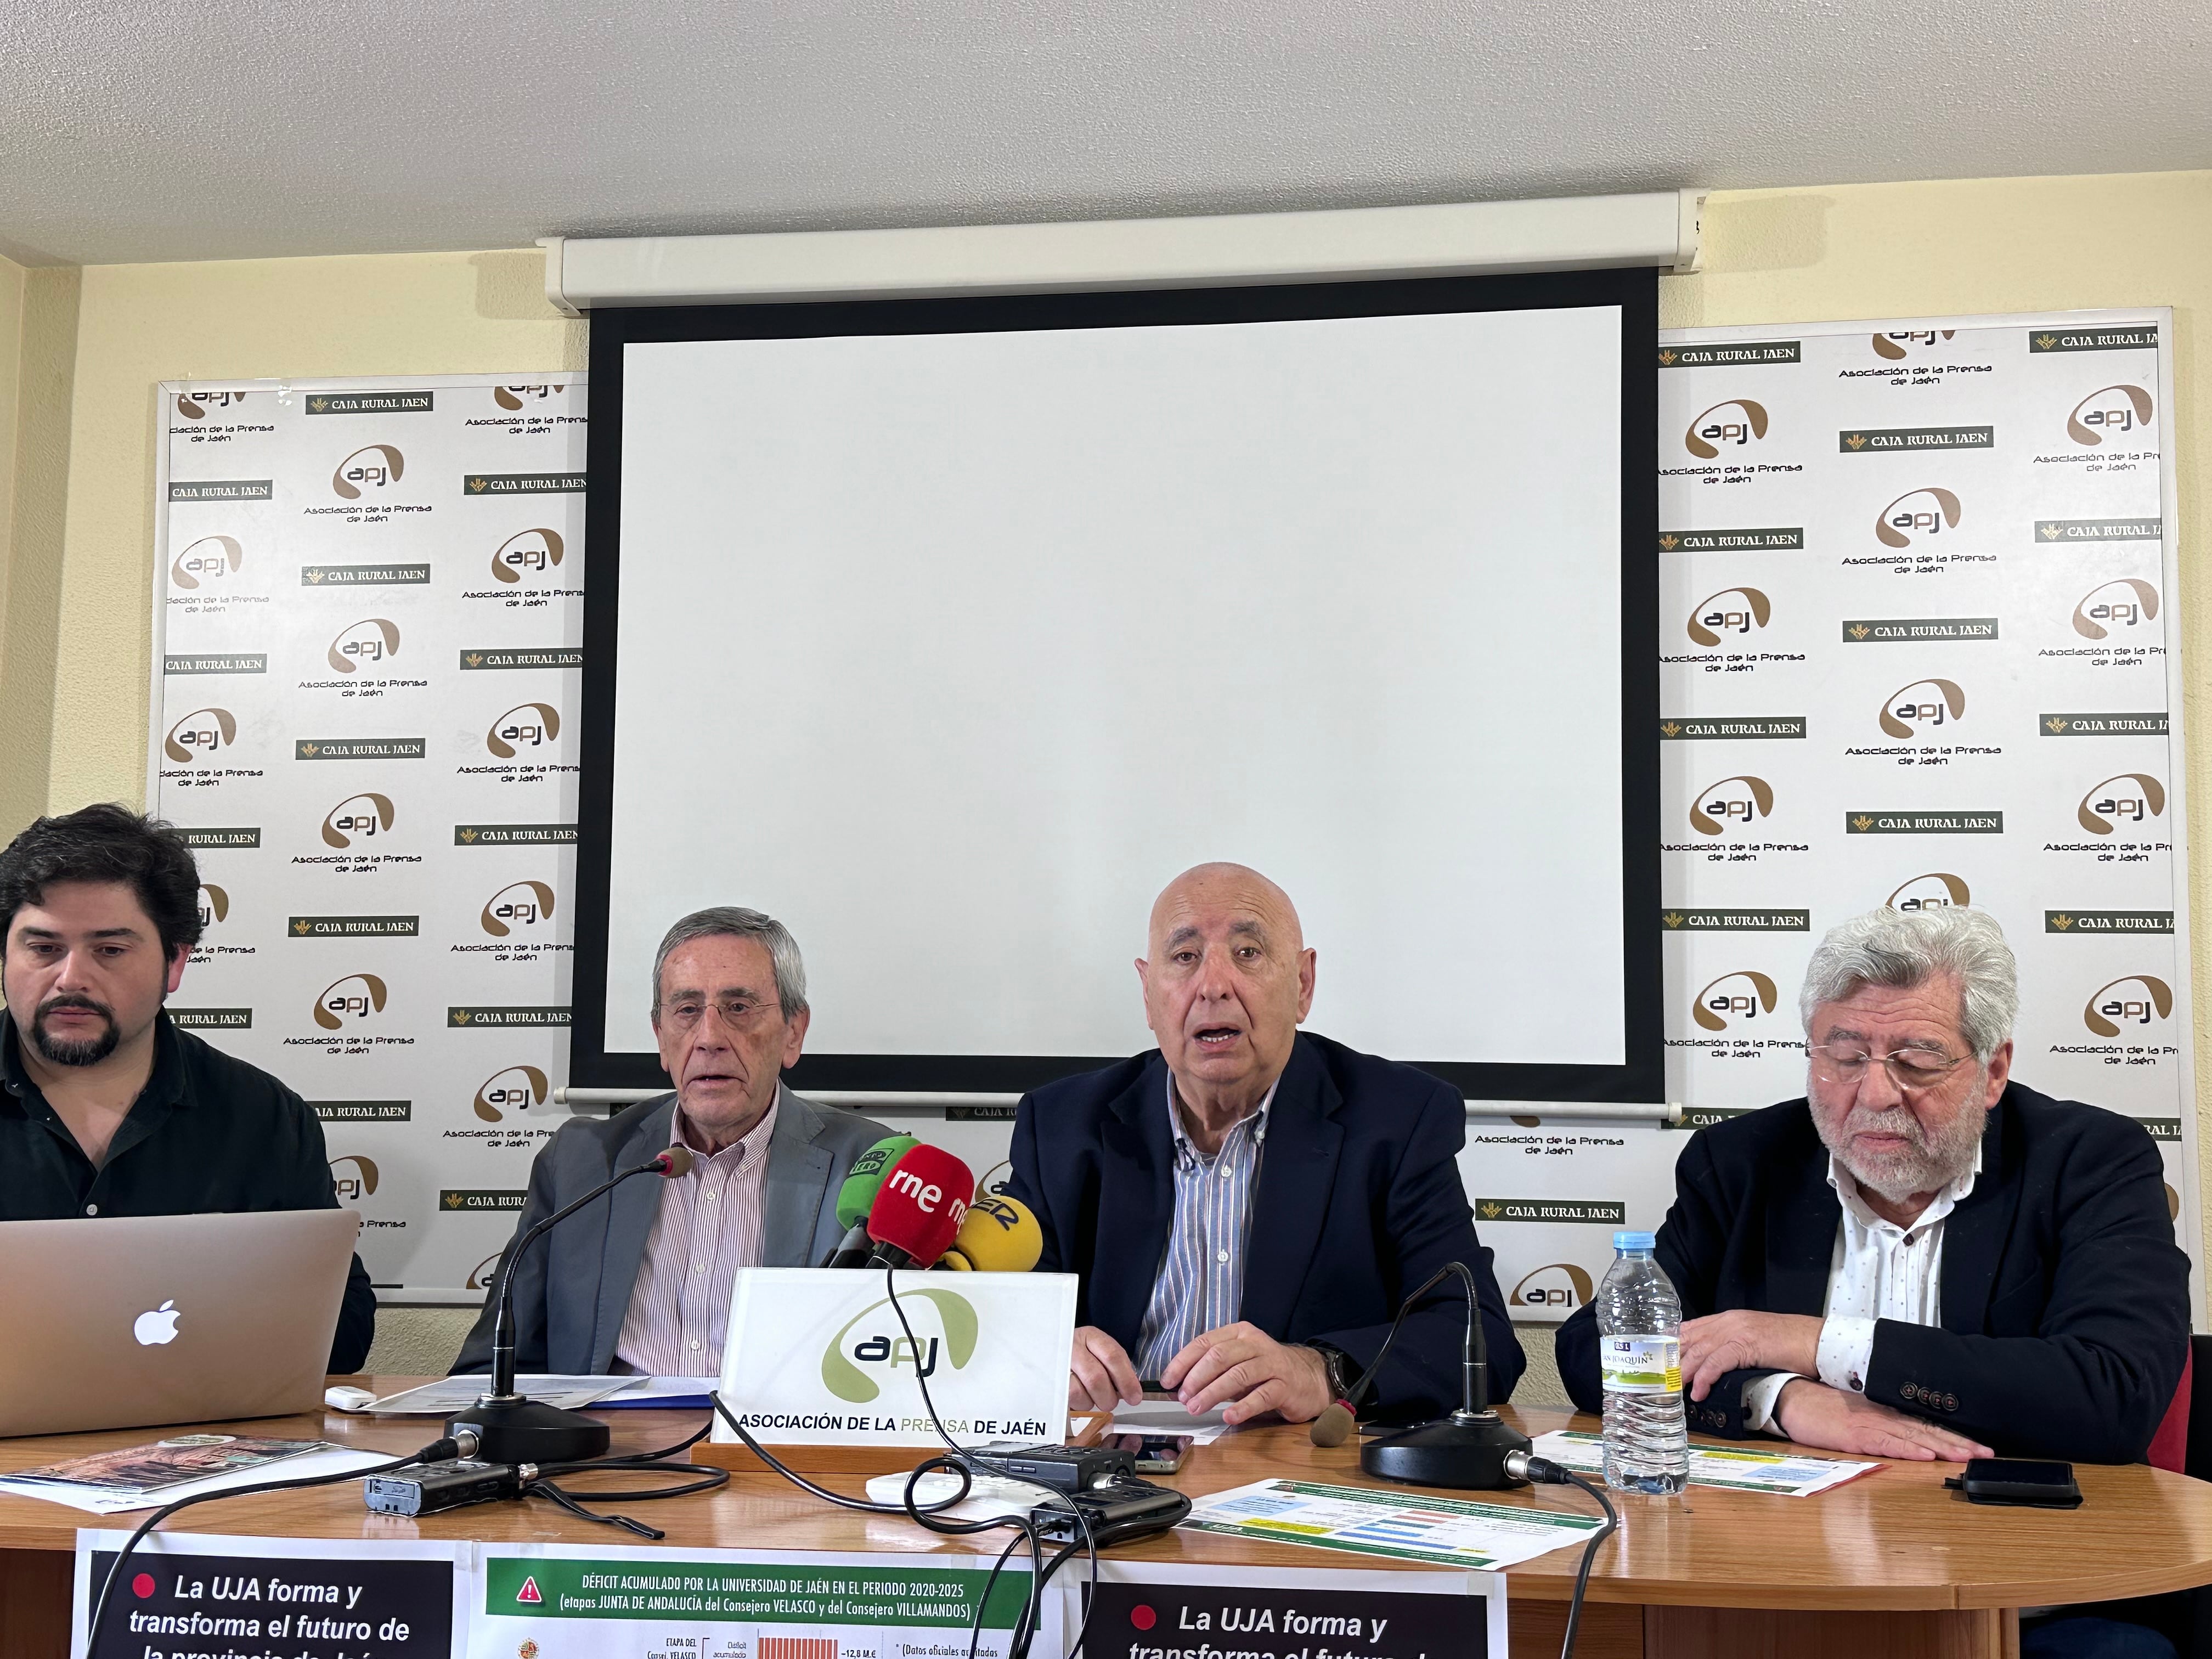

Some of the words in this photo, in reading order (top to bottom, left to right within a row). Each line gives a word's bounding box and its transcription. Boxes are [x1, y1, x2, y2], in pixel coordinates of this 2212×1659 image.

[1682, 352, 1713, 362] CAJA
[1716, 350, 1760, 360] RURAL
[1763, 348, 1795, 359] JAEN
[1839, 368, 1909, 377] Asociación
[1911, 376, 1940, 385] Jaén
[332, 400, 358, 409] CAJA
[362, 399, 399, 408] RURAL
[402, 398, 428, 408] JAEN
[2085, 410, 2131, 431] apj
[1871, 437, 1903, 446] CAJA
[1907, 435, 1953, 445] RURAL
[1956, 433, 1988, 444] JAEN
[348, 468, 386, 486] apj
[172, 488, 199, 497] CAJA
[202, 487, 239, 496] RURAL
[241, 486, 268, 496] JAEN
[1893, 512, 1939, 534] apj
[1842, 556, 1912, 565] Asociación
[328, 572, 355, 582] CAJA
[358, 571, 396, 580] RURAL
[398, 570, 425, 579] JAEN
[1704, 613, 1750, 633] apj
[1875, 627, 1907, 636] CAJA
[1911, 626, 1956, 636] RURAL
[1960, 625, 1992, 636] JAEN
[343, 642, 381, 661] apj
[1897, 704, 1943, 725] apj
[503, 728, 541, 746] apj
[1686, 725, 1717, 735] CAJA
[1721, 724, 1765, 733] RURAL
[1769, 724, 1800, 733] JAEN
[323, 746, 349, 754] CAJA
[353, 745, 391, 754] RURAL
[393, 744, 420, 754] JAEN
[1918, 757, 1948, 765] Jaén
[2095, 799, 2142, 821] apj
[337, 817, 376, 836] apj
[1878, 819, 1911, 828] CAJA
[1915, 819, 1961, 828] RURAL
[1965, 818, 1996, 828] JAEN
[315, 923, 342, 932] CAJA
[346, 923, 384, 932] RURAL
[387, 922, 414, 932] JAEN
[329, 998, 368, 1017] apj
[1475, 1136, 1543, 1144] Asociación
[1525, 1146, 1541, 1154] de
[1545, 1147, 1573, 1155] Jaén
[889, 1169, 942, 1213] rne
[1506, 1206, 1537, 1217] CAJA
[1541, 1207, 1585, 1217] RURAL
[1588, 1208, 1619, 1218] JAEN
[854, 1336, 938, 1378] apj
[739, 1413, 842, 1429] ASOCIACIÓN
[847, 1417, 870, 1430] DE
[875, 1418, 896, 1431] LA
[974, 1420, 997, 1434] DE
[1001, 1418, 1046, 1435] JAÉN
[174, 1575, 203, 1599] La
[212, 1577, 260, 1601] UJA
[268, 1578, 338, 1602] forma
[346, 1586, 363, 1609] y
[583, 1572, 618, 1589] DÉFICIT
[620, 1576, 680, 1590] ACUMULADO
[684, 1577, 703, 1590] POR
[707, 1578, 719, 1591] LA
[723, 1578, 786, 1593] UNIVERSIDAD
[791, 1580, 803, 1593] DE
[805, 1578, 828, 1594] JAÉN
[833, 1581, 845, 1594] EN
[849, 1582, 860, 1594] EL
[863, 1582, 906, 1595] PERIODO
[910, 1583, 963, 1597] 2020-2025
[560, 1593, 595, 1611] (etapas
[599, 1595, 629, 1609] JUNTA
[632, 1596, 645, 1609] DE
[647, 1595, 702, 1610] ANDALUCÍA
[706, 1596, 720, 1611] del
[724, 1598, 770, 1615] Consejero
[773, 1599, 815, 1613] VELASCO
[819, 1605, 825, 1617] y
[828, 1599, 842, 1614] del
[847, 1601, 893, 1618] Consejero
[896, 1602, 970, 1621] VILLAMANDOS)
[130, 1610, 260, 1637] transforma
[268, 1615, 290, 1637] el
[297, 1615, 371, 1640] futuro
[379, 1618, 409, 1641] de
[1179, 1606, 1210, 1630] La
[1221, 1607, 1274, 1633] UJA
[1283, 1610, 1361, 1636] forma
[1370, 1619, 1387, 1643] y
